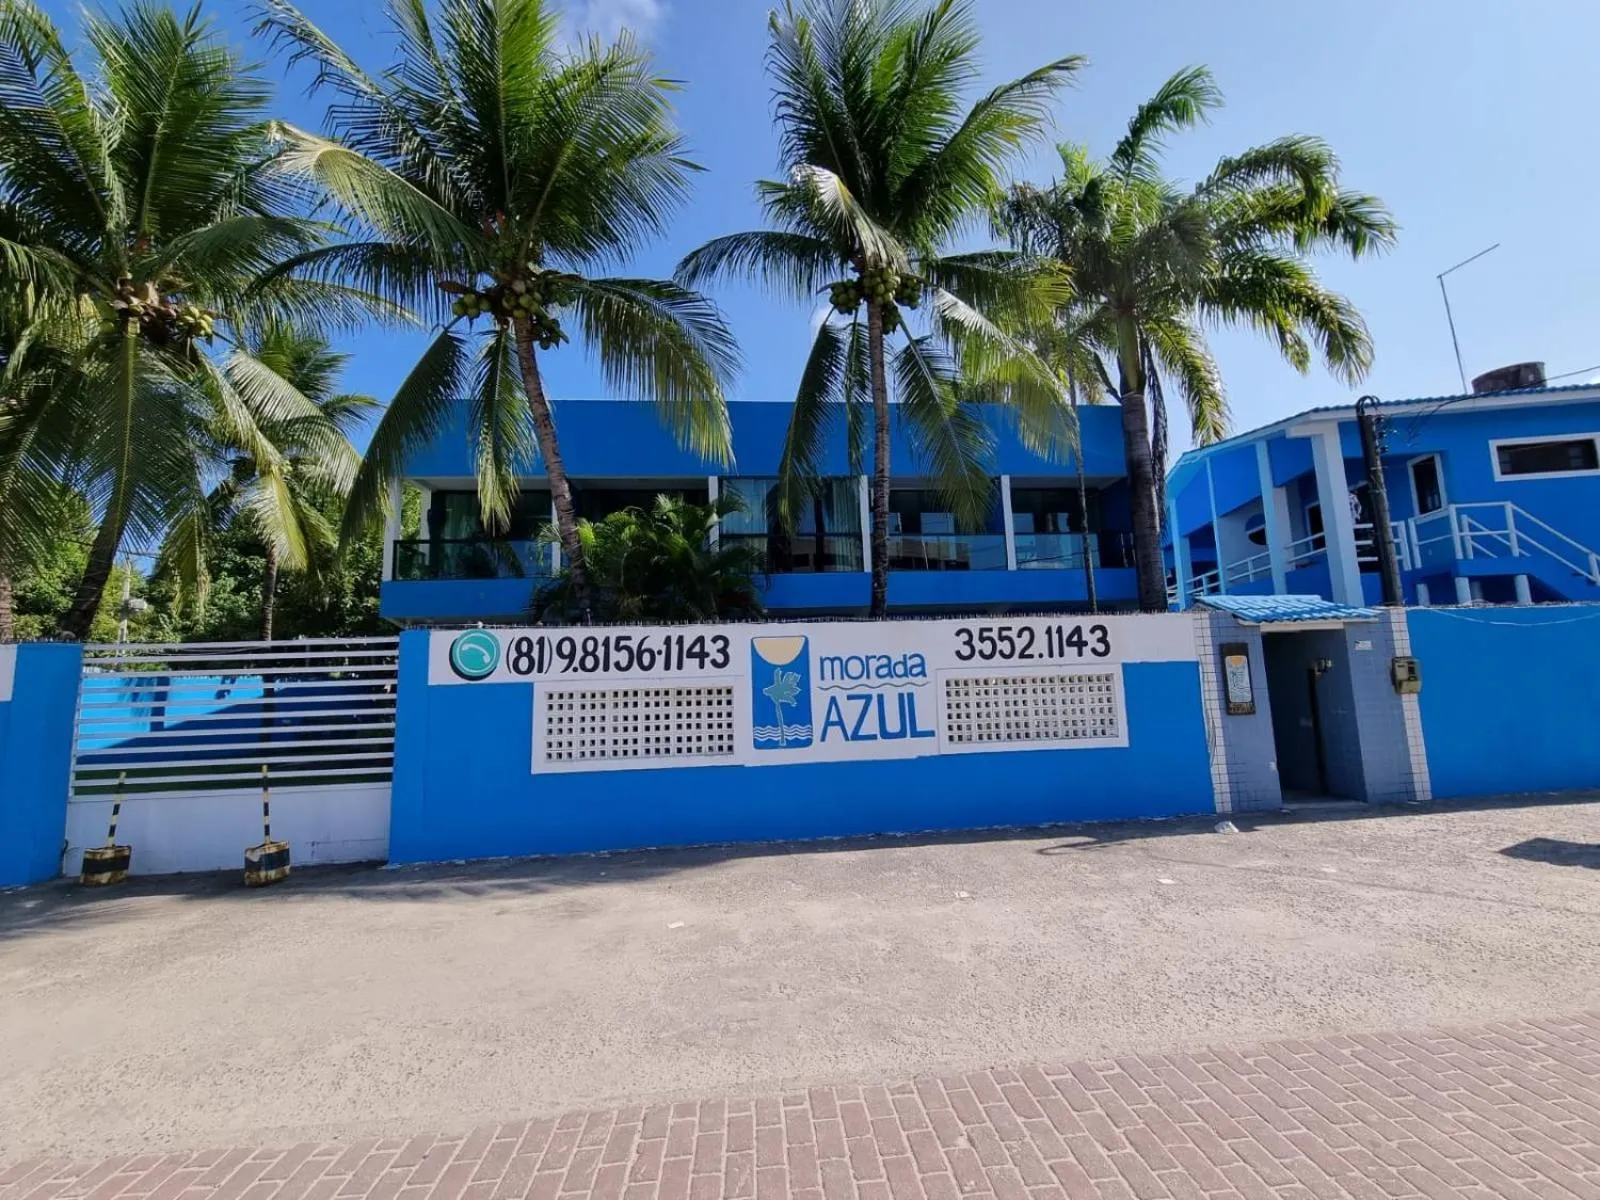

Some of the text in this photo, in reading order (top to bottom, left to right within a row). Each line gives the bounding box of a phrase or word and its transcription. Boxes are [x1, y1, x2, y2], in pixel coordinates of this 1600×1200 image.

[954, 624, 1111, 661] 3552.1143
[819, 652, 927, 681] morada
[819, 691, 936, 743] AZUL
